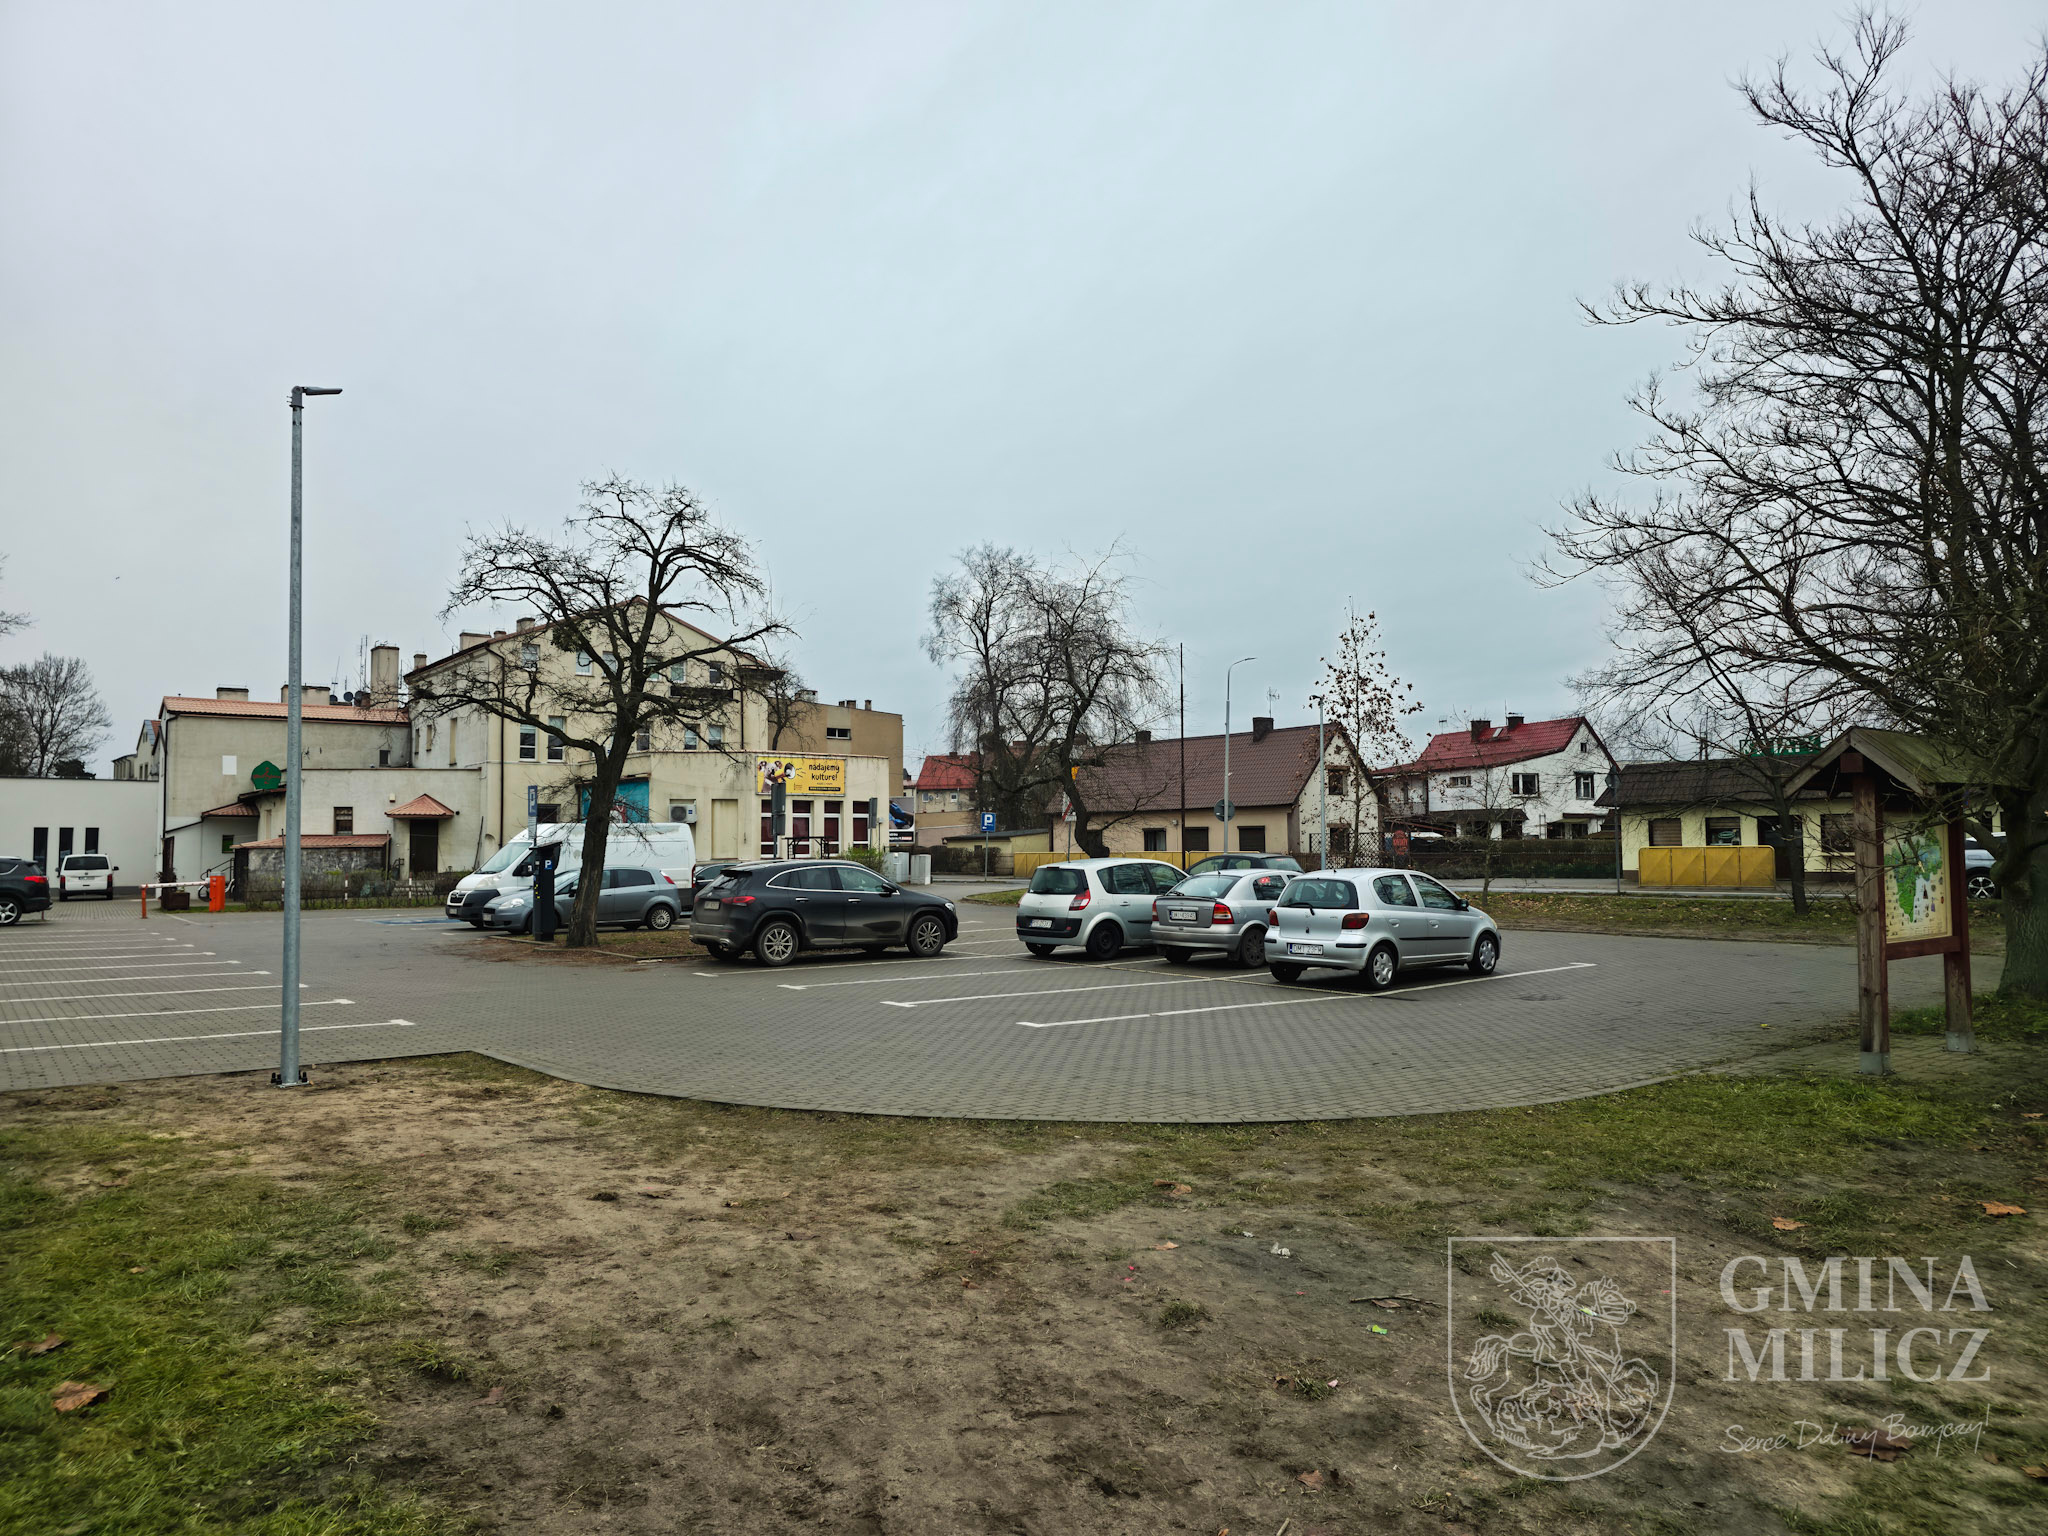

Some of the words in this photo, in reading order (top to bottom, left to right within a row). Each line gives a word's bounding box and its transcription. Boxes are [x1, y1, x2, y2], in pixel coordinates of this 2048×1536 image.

[808, 763, 840, 774] nadajemy
[984, 814, 993, 826] P
[545, 860, 551, 869] P
